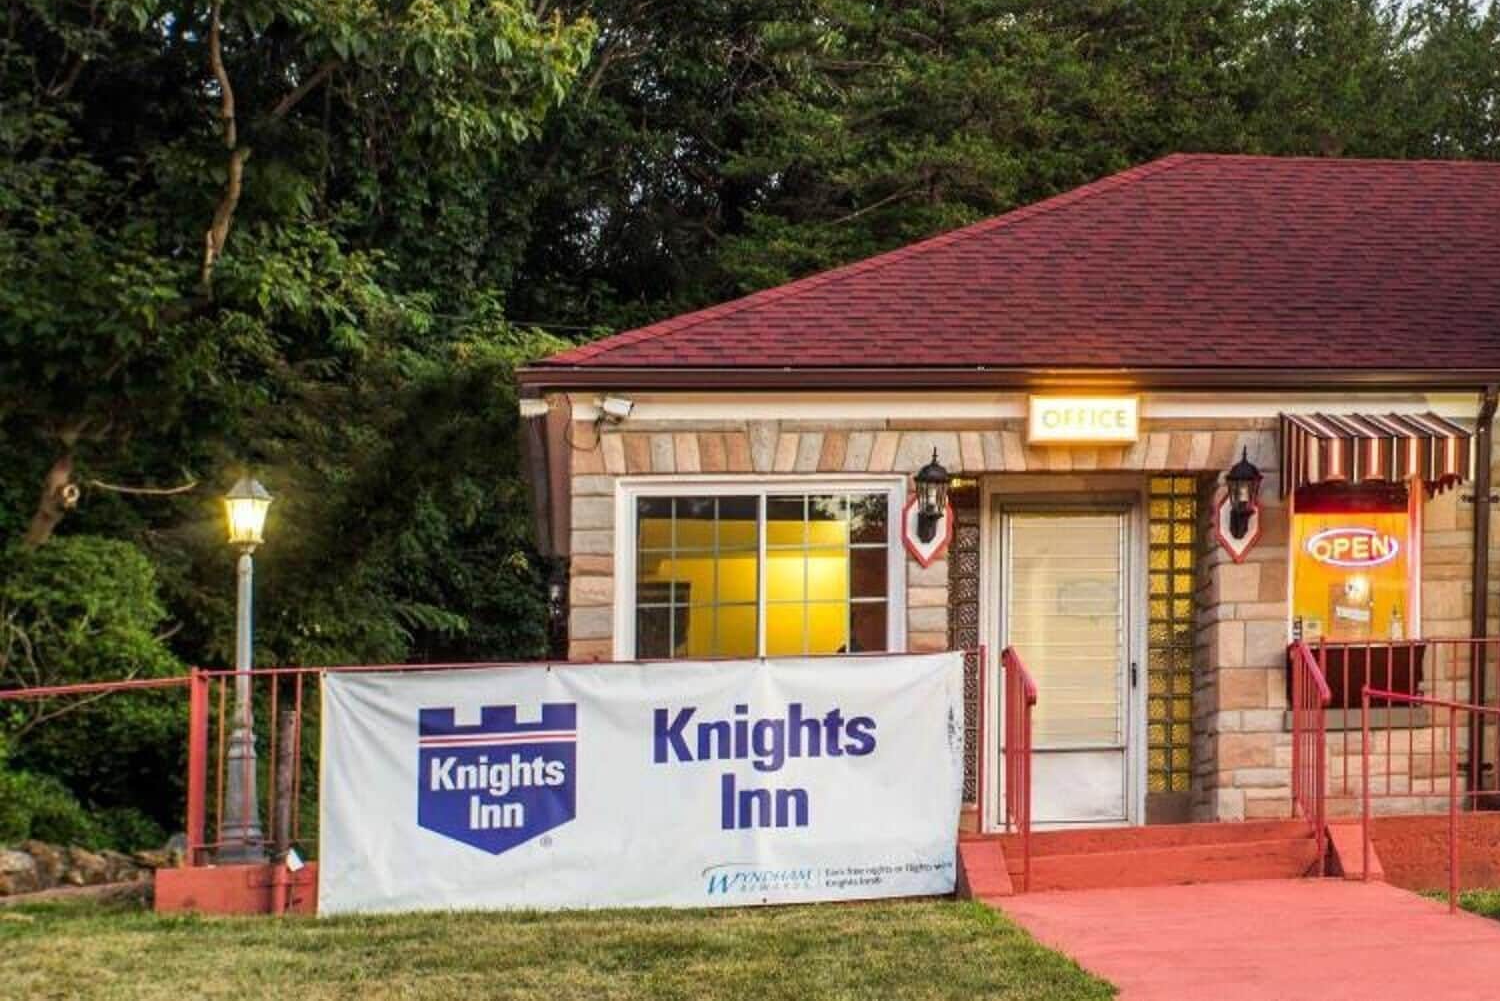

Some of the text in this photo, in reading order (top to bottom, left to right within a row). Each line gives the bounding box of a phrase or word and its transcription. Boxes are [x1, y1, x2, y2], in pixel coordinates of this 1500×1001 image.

[1042, 407, 1128, 429] OFFICE
[1311, 535, 1390, 562] OPEN
[653, 702, 878, 773] Knights
[430, 754, 566, 796] Knights
[469, 795, 525, 830] Inn
[721, 773, 809, 830] Inn
